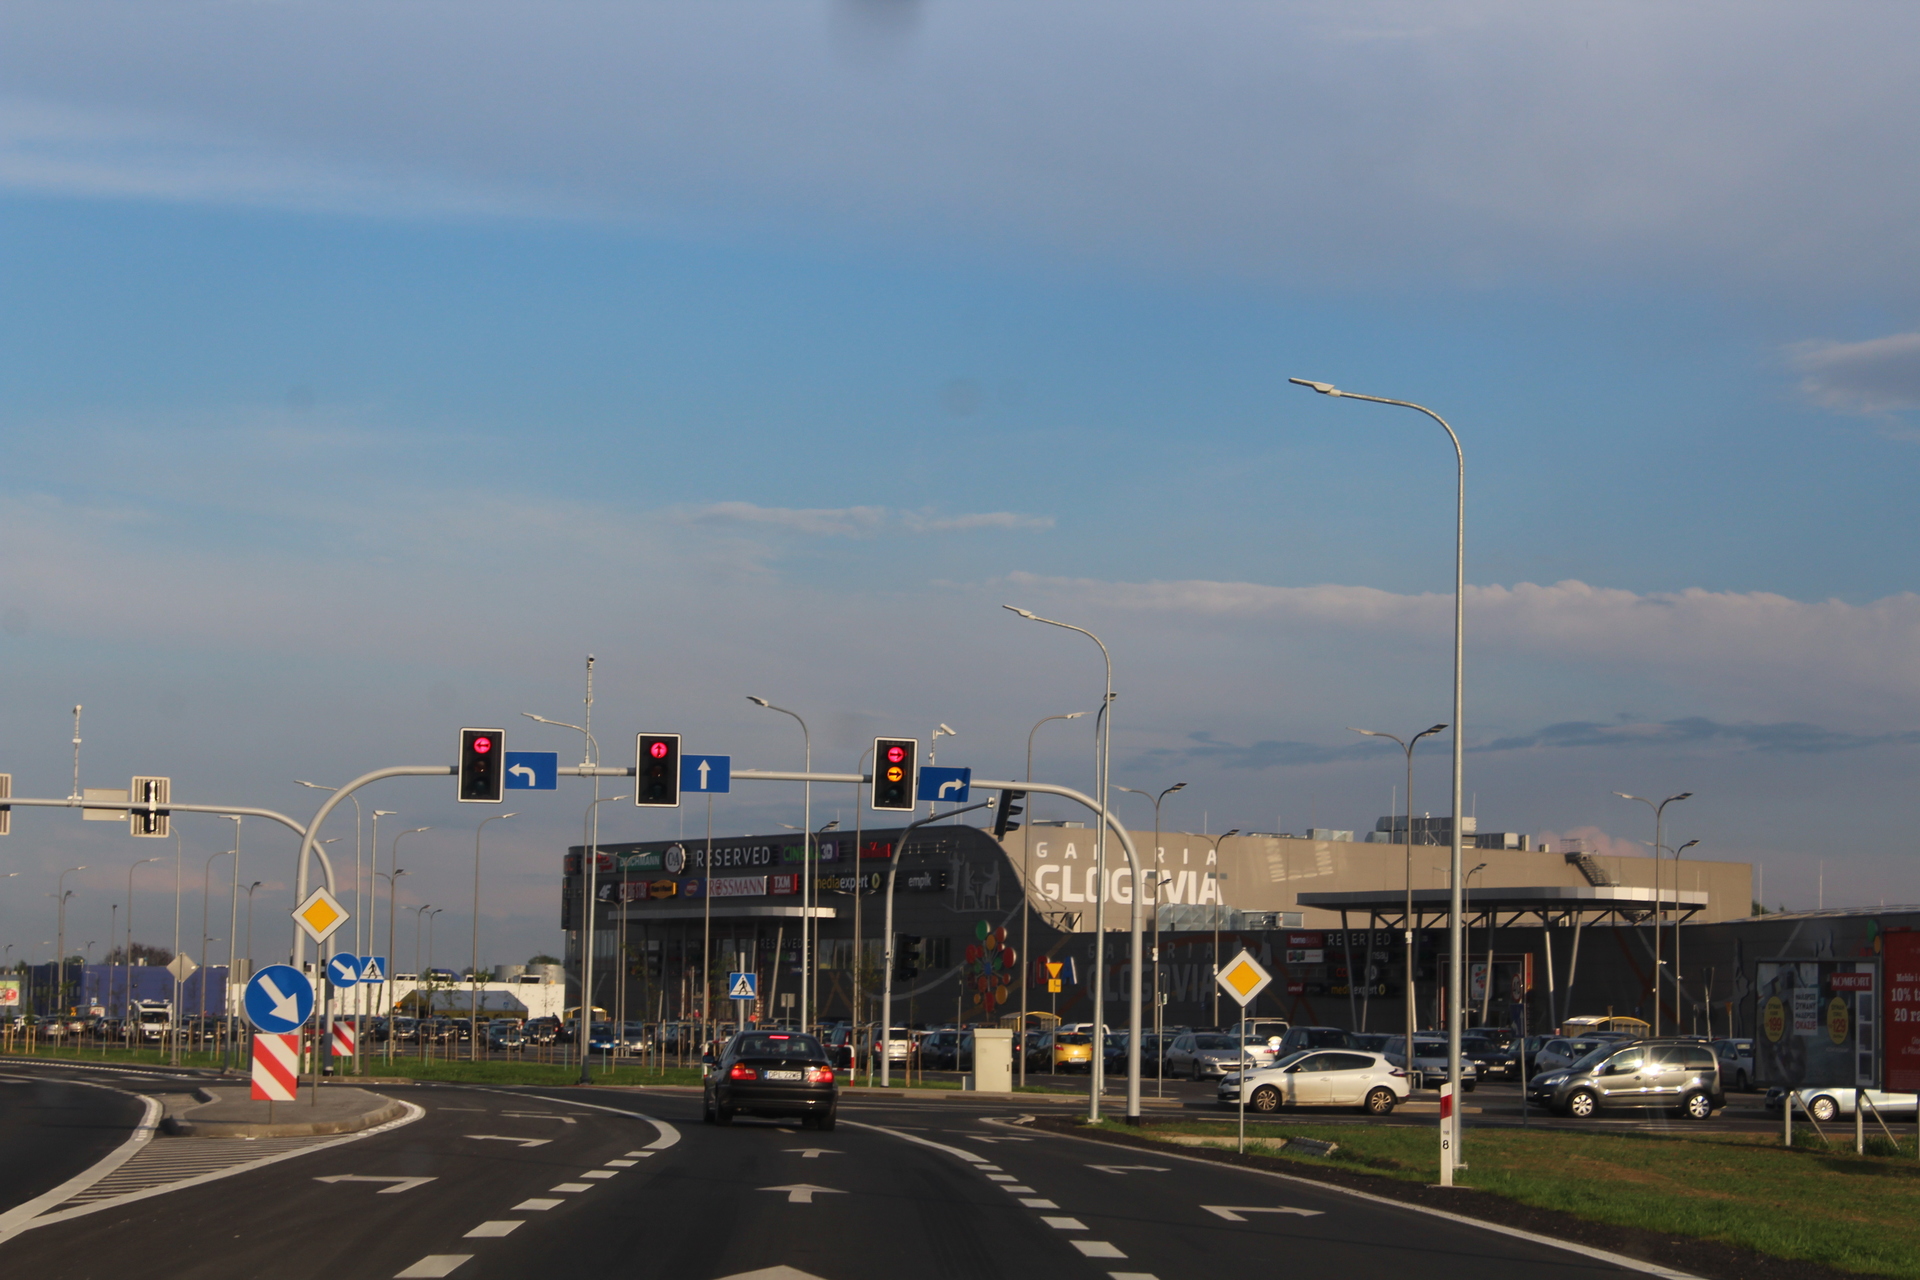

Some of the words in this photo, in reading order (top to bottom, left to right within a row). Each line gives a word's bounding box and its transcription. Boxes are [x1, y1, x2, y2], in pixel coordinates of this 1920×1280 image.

[696, 846, 770, 868] RESERVED
[1036, 841, 1217, 866] GALRIA
[709, 878, 765, 896] ROSSMANN
[774, 876, 791, 888] TXM
[907, 872, 930, 889] empik
[1034, 864, 1223, 906] GLOGOVIA
[598, 884, 612, 899] 4F
[760, 938, 803, 949] RESRVED
[1328, 933, 1391, 946] REERED
[1832, 977, 1870, 987] KOMFORT
[1891, 987, 1911, 1002] 10%
[1894, 1008, 1908, 1022] 20
[1832, 1018, 1846, 1033] 129
[1443, 1140, 1449, 1149] 8
